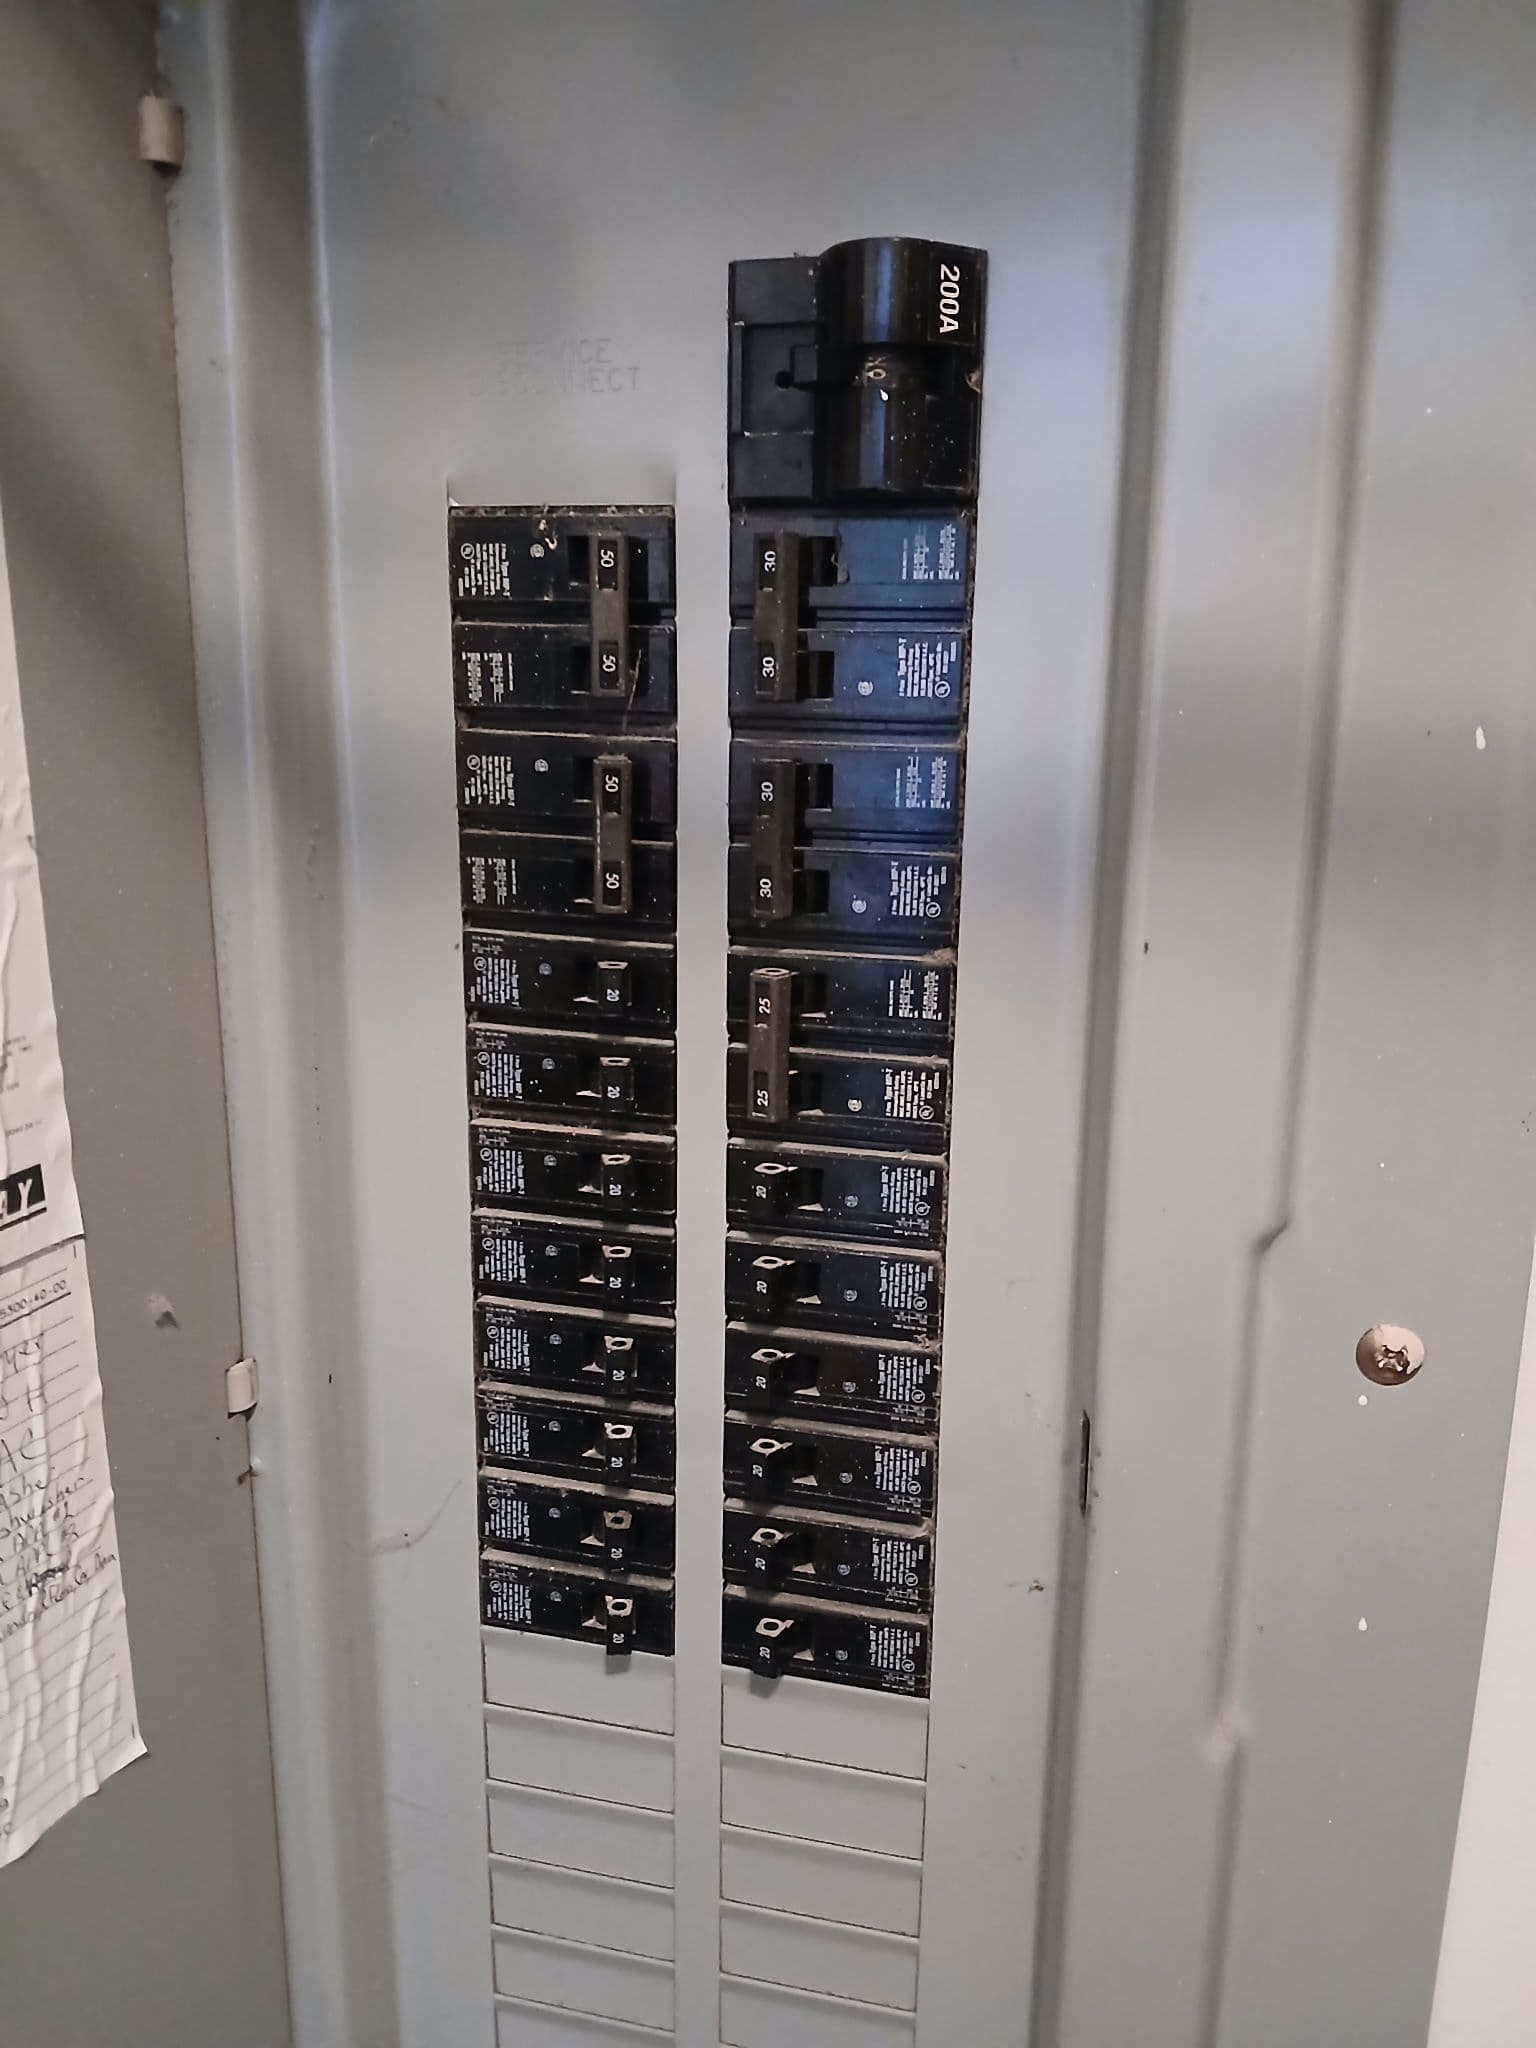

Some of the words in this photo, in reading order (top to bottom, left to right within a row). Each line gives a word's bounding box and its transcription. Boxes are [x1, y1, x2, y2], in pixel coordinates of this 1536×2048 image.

[939, 263, 961, 334] 200A
[600, 549, 615, 568] 50
[764, 550, 776, 572] 30
[602, 654, 616, 673] 50
[762, 656, 775, 678] 30
[605, 774, 619, 793] 50
[760, 781, 774, 802] 30
[605, 872, 620, 889] 50
[759, 878, 774, 898] 30
[606, 988, 620, 1002] 20
[758, 997, 771, 1015] 25
[606, 1085, 621, 1099] 20
[756, 1089, 769, 1107] 25
[609, 1183, 622, 1196] 20
[755, 1185, 767, 1199] 20
[609, 1276, 622, 1289] 20
[756, 1280, 768, 1294] 20
[612, 1369, 625, 1381] 20
[755, 1375, 767, 1389] 20
[610, 1456, 624, 1468] 20
[752, 1464, 763, 1478] 20
[610, 1547, 623, 1559] 20
[754, 1557, 766, 1571] 20
[612, 1633, 625, 1644] 20
[759, 1646, 771, 1659] 20
